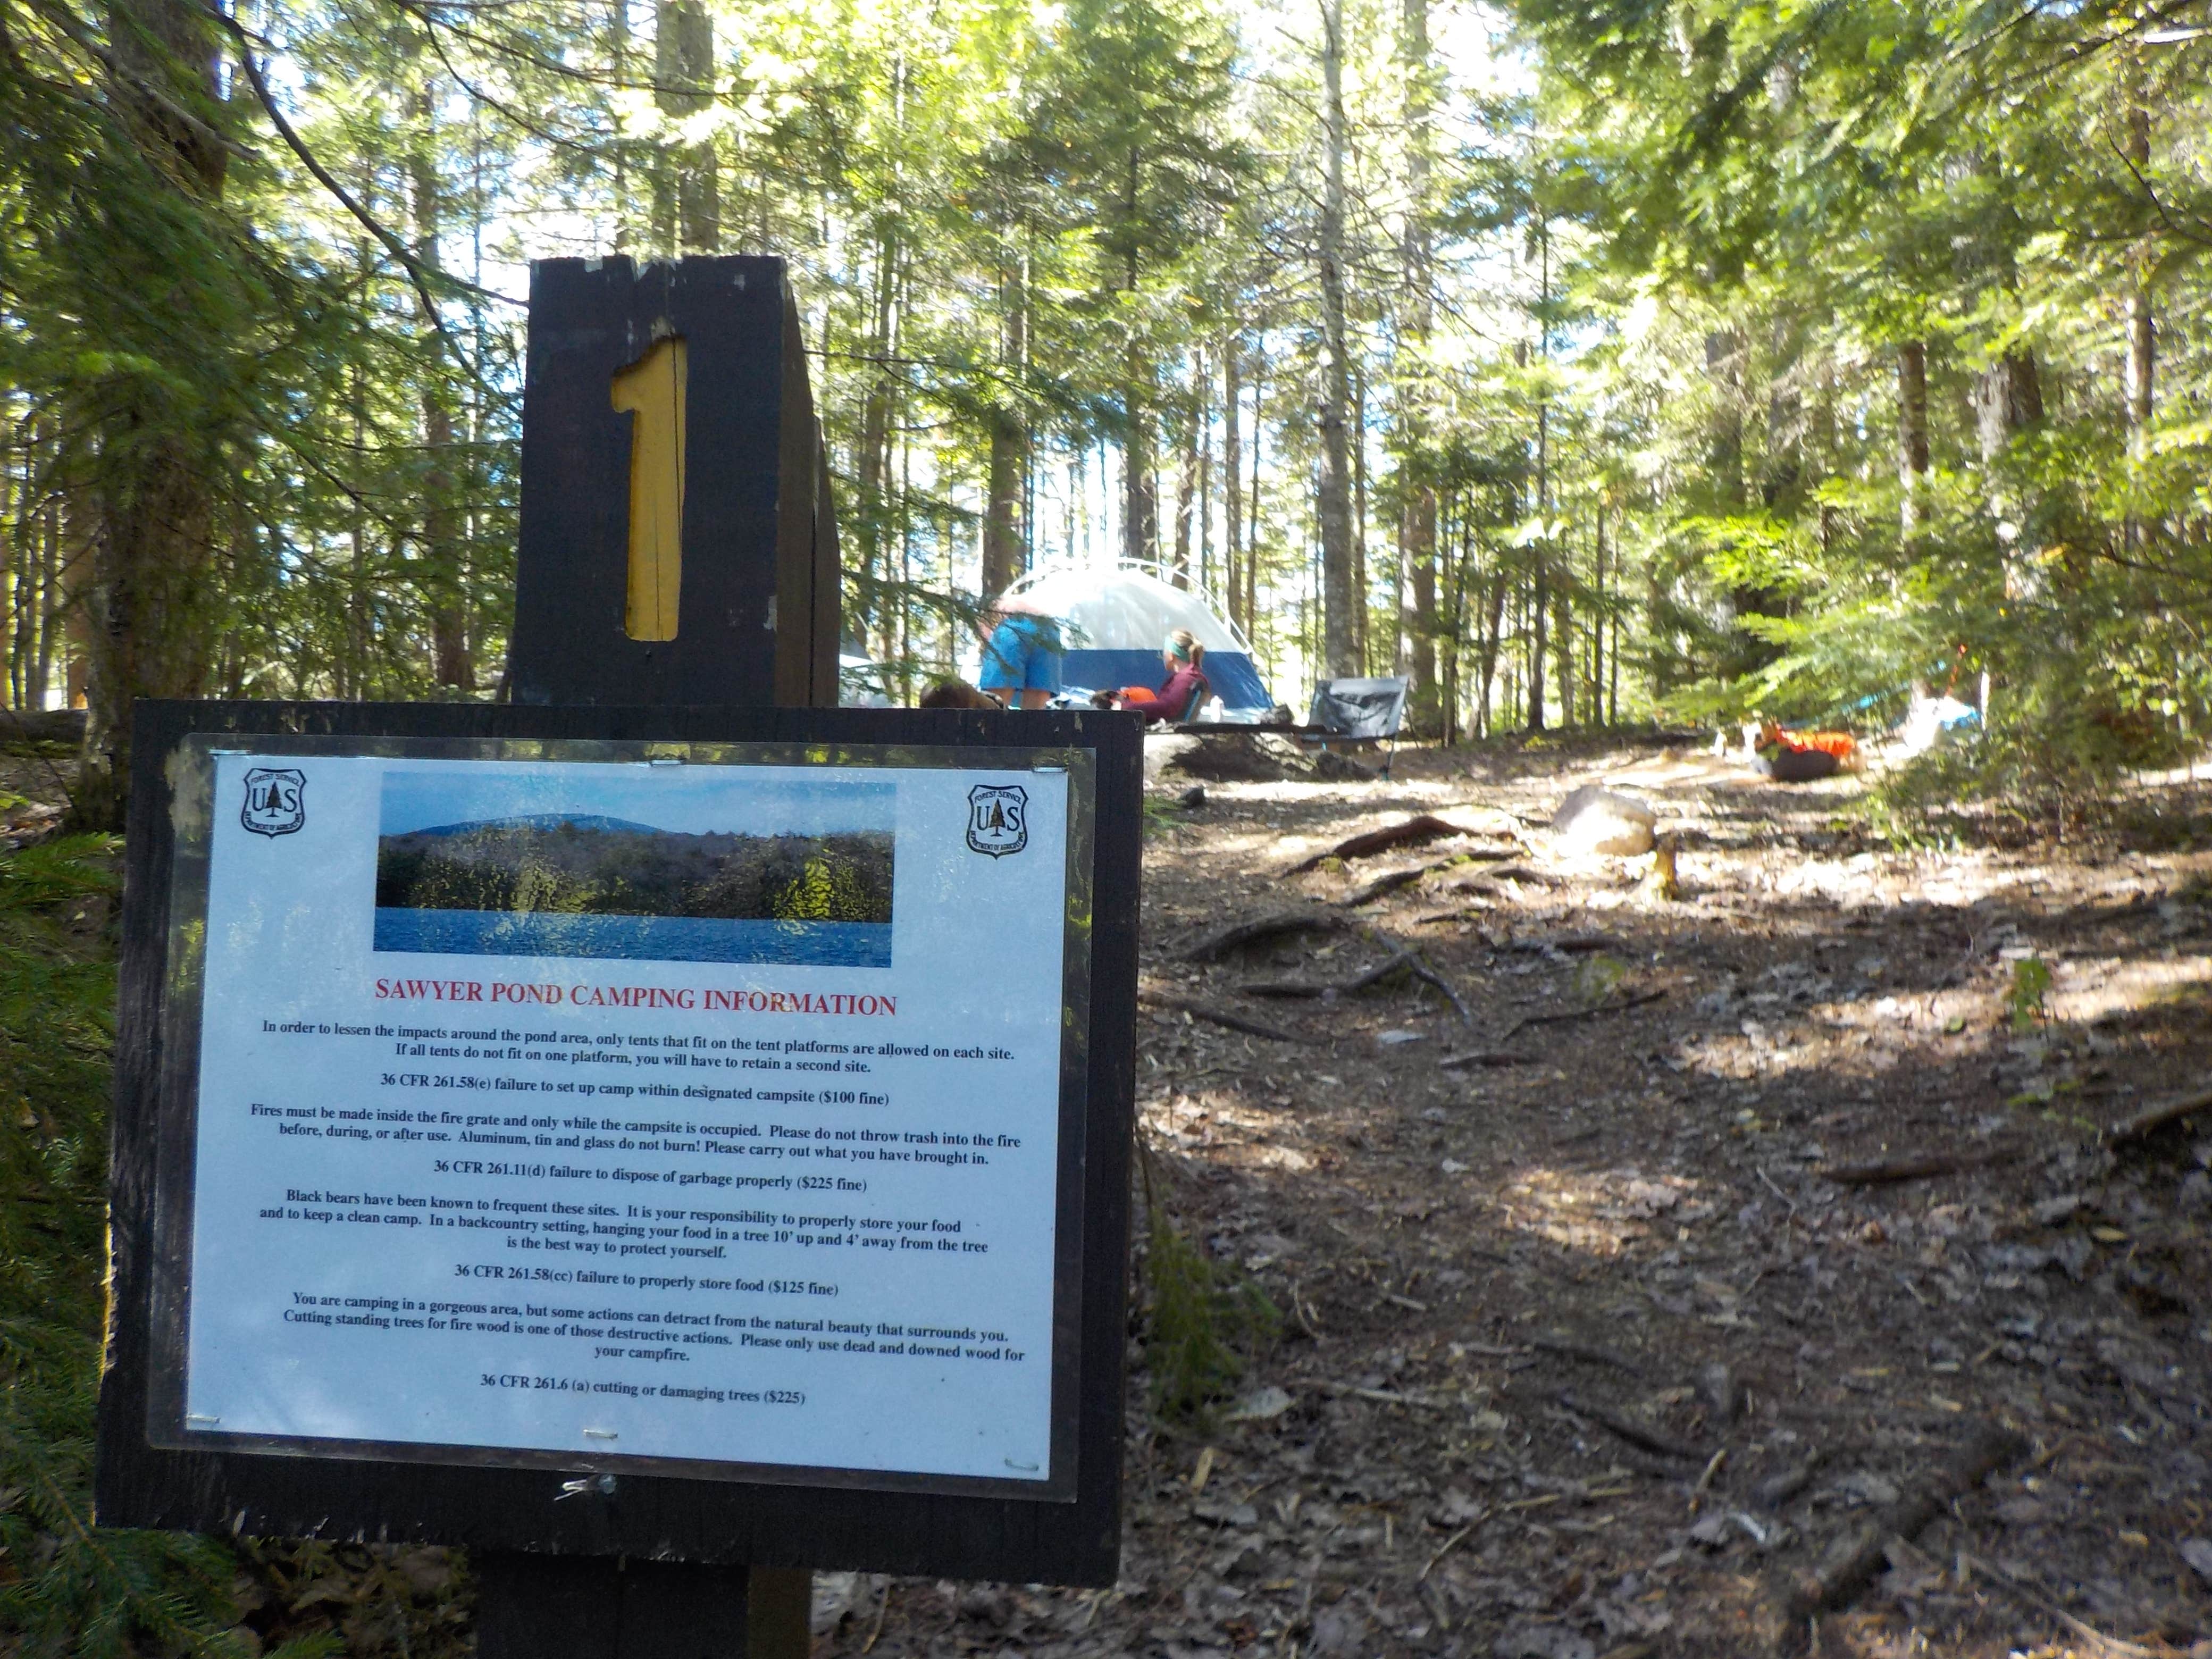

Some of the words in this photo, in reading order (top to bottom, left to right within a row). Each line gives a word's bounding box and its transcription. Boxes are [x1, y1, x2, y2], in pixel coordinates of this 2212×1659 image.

[610, 333, 688, 642] 1
[975, 791, 996, 803] FOREST
[998, 790, 1021, 804] SERVICE
[375, 978, 483, 1002] SAWYER
[490, 982, 563, 1004] POND
[569, 985, 695, 1009] CAMPING
[703, 990, 897, 1016] INFORMATION
[263, 1020, 276, 1033] In
[280, 1020, 315, 1034] order
[319, 1023, 330, 1035] to
[334, 1022, 371, 1036] lessen
[375, 1024, 394, 1037] the
[398, 1024, 447, 1041] impacts
[451, 1028, 497, 1041] around
[501, 1028, 521, 1042] the
[525, 1030, 557, 1045] pond
[561, 1034, 592, 1046] area,
[596, 1033, 622, 1049] only
[629, 1035, 659, 1047] tents
[663, 1035, 688, 1048] that
[693, 1035, 706, 1049] fit
[711, 1040, 726, 1050] on
[732, 1037, 751, 1050] the
[756, 1040, 780, 1051] tent
[785, 1039, 849, 1055] platforms
[853, 1044, 874, 1055] are
[878, 1042, 928, 1058] allowed
[933, 1048, 949, 1058] on
[953, 1046, 984, 1059] each
[988, 1046, 1014, 1060] site.
[397, 1043, 407, 1055] If
[410, 1043, 425, 1056] all
[430, 1045, 460, 1058] tents
[464, 1045, 479, 1059] do
[483, 1048, 503, 1059] not
[508, 1046, 521, 1060] fit
[525, 1051, 541, 1061] on
[545, 1052, 567, 1062] one
[572, 1050, 632, 1066] platform,
[636, 1055, 659, 1068] you
[664, 1053, 686, 1066] will
[691, 1053, 721, 1068] have
[726, 1057, 738, 1068] to
[742, 1057, 780, 1070] retain
[785, 1061, 792, 1070] a
[796, 1059, 840, 1072] second
[845, 1059, 870, 1073] site.
[380, 1073, 396, 1086] 36
[399, 1073, 430, 1087] CFR
[433, 1075, 491, 1091] 261.58(e)
[495, 1077, 538, 1092] failure
[540, 1080, 554, 1092] to
[556, 1082, 575, 1093] set
[578, 1084, 596, 1097] up
[598, 1085, 634, 1098] camp
[638, 1083, 680, 1097] within
[683, 1084, 752, 1102] designated
[756, 1089, 815, 1105] campsite
[818, 1090, 856, 1105] ($100
[859, 1091, 889, 1107] fine)
[250, 1103, 283, 1117] Fires
[286, 1107, 317, 1118] must
[320, 1106, 336, 1119] be
[339, 1108, 374, 1120] made
[376, 1108, 414, 1122] inside
[417, 1110, 438, 1124] the
[440, 1111, 463, 1125] fire
[466, 1115, 500, 1128] grate
[503, 1114, 527, 1127] and
[531, 1116, 559, 1131] only
[563, 1116, 598, 1130] while
[601, 1118, 621, 1131] the
[624, 1120, 683, 1136] campsite
[685, 1121, 697, 1134] is
[699, 1123, 761, 1139] occupied.
[769, 1125, 811, 1139] Please
[814, 1126, 831, 1140] do
[835, 1129, 856, 1141] not
[860, 1128, 900, 1143] throw
[904, 1131, 939, 1144] trash
[942, 1132, 969, 1145] into
[973, 1133, 994, 1147] the
[998, 1134, 1021, 1148] fire
[433, 1159, 450, 1172] 36
[452, 1160, 483, 1174] CFR
[487, 1161, 546, 1178] 261.11(d)
[549, 1164, 593, 1179] failure
[596, 1168, 609, 1179] to
[611, 1167, 660, 1184] dispose
[662, 1170, 677, 1183] of
[678, 1171, 733, 1188] garbage
[735, 1175, 793, 1191] properly
[797, 1176, 833, 1190] ($225
[836, 1177, 867, 1193] fine)
[507, 1235, 518, 1248] is
[521, 1236, 541, 1250] the
[544, 1237, 571, 1251] best
[574, 1242, 601, 1255] way
[604, 1241, 617, 1253] to
[620, 1243, 667, 1257] protect
[669, 1245, 727, 1260] yourself.
[454, 1263, 470, 1277] 36
[473, 1264, 505, 1279] CFR
[508, 1266, 573, 1284] 261.58(cc)
[576, 1269, 619, 1285] failure
[623, 1273, 635, 1285] to
[639, 1275, 696, 1291] properly
[699, 1278, 732, 1291] store
[735, 1278, 764, 1292] food
[768, 1279, 805, 1294] ($125
[808, 1281, 839, 1296] fine)
[283, 1309, 332, 1327] Cutting
[335, 1313, 390, 1330] standing
[394, 1316, 424, 1329] trees
[428, 1316, 447, 1330] for
[450, 1317, 473, 1331] fire
[476, 1320, 510, 1333] wood
[514, 1320, 524, 1334] is
[527, 1325, 550, 1335] one
[554, 1323, 568, 1336] of
[571, 1324, 604, 1338] those
[607, 1326, 680, 1343] destructive
[682, 1331, 733, 1345] actions.
[741, 1333, 782, 1348] Please
[785, 1336, 814, 1353] only
[818, 1340, 840, 1351] use
[843, 1339, 875, 1353] dead
[879, 1342, 904, 1355] and
[908, 1342, 960, 1359] downed
[965, 1347, 1000, 1361] wood
[1005, 1347, 1025, 1362] for
[595, 1347, 624, 1359] your
[629, 1347, 690, 1363] campfire.
[480, 1373, 496, 1387] 36
[499, 1374, 530, 1389] CFR
[534, 1376, 568, 1391] 261.6
[572, 1379, 590, 1394] (a)
[593, 1381, 639, 1398] cutting
[642, 1386, 657, 1396] or
[659, 1384, 725, 1403] damaging
[728, 1389, 760, 1403] trees
[764, 1389, 806, 1405] ($225)
